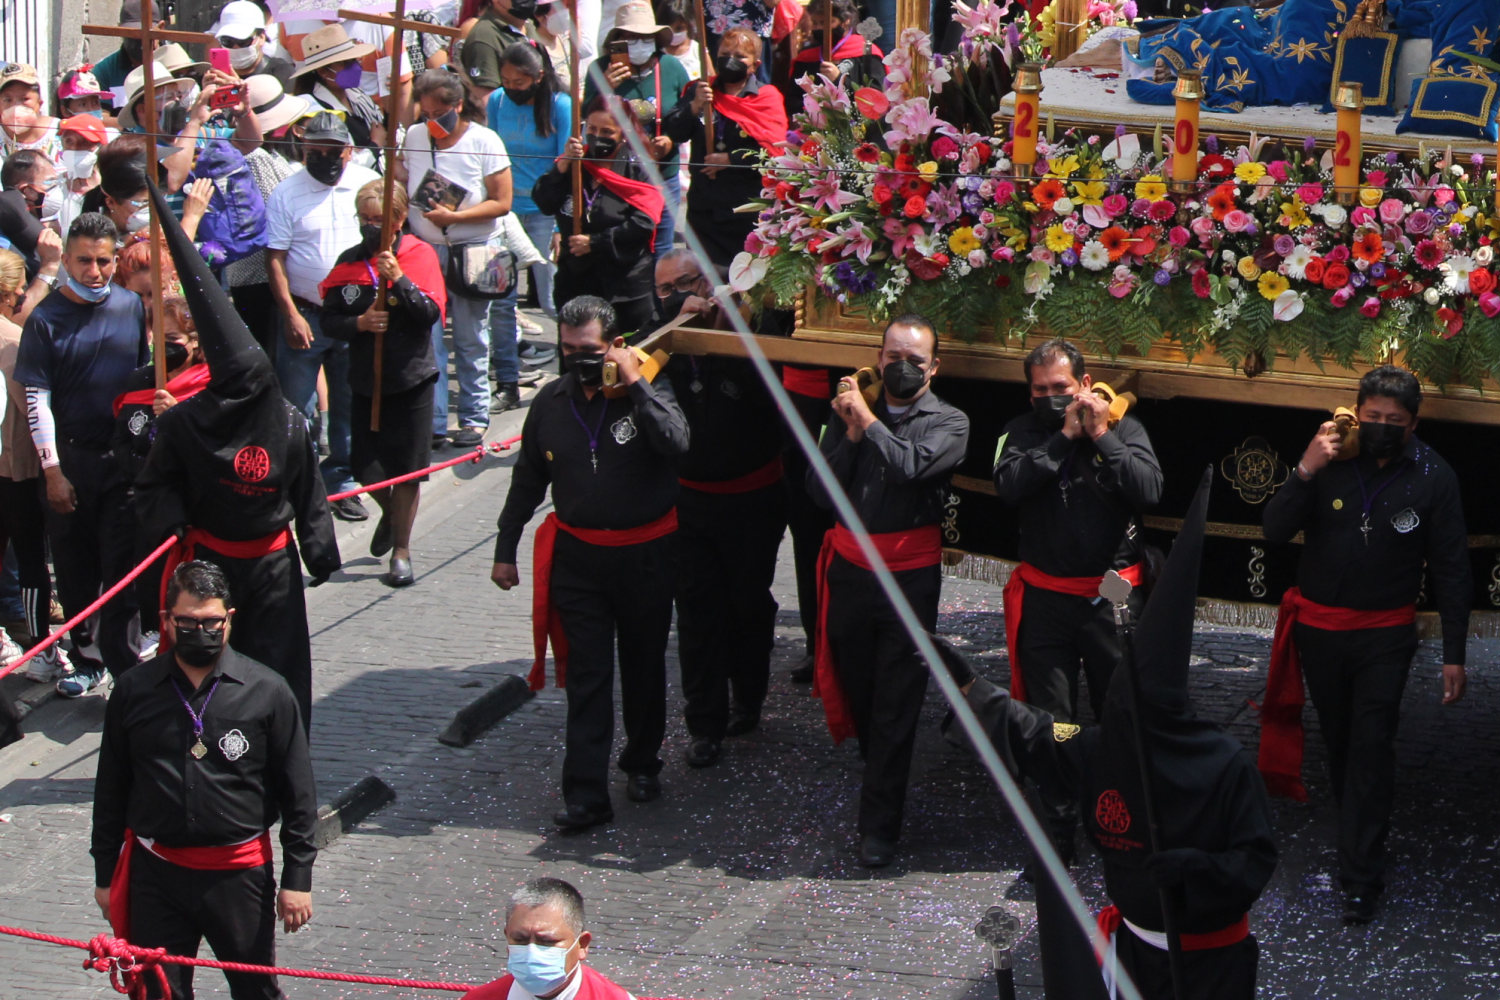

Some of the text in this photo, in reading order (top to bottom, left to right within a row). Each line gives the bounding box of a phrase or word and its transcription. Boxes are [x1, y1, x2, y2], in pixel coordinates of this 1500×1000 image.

[1014, 102, 1034, 139] 2
[1175, 120, 1195, 156] 0
[1334, 130, 1352, 167] 2
